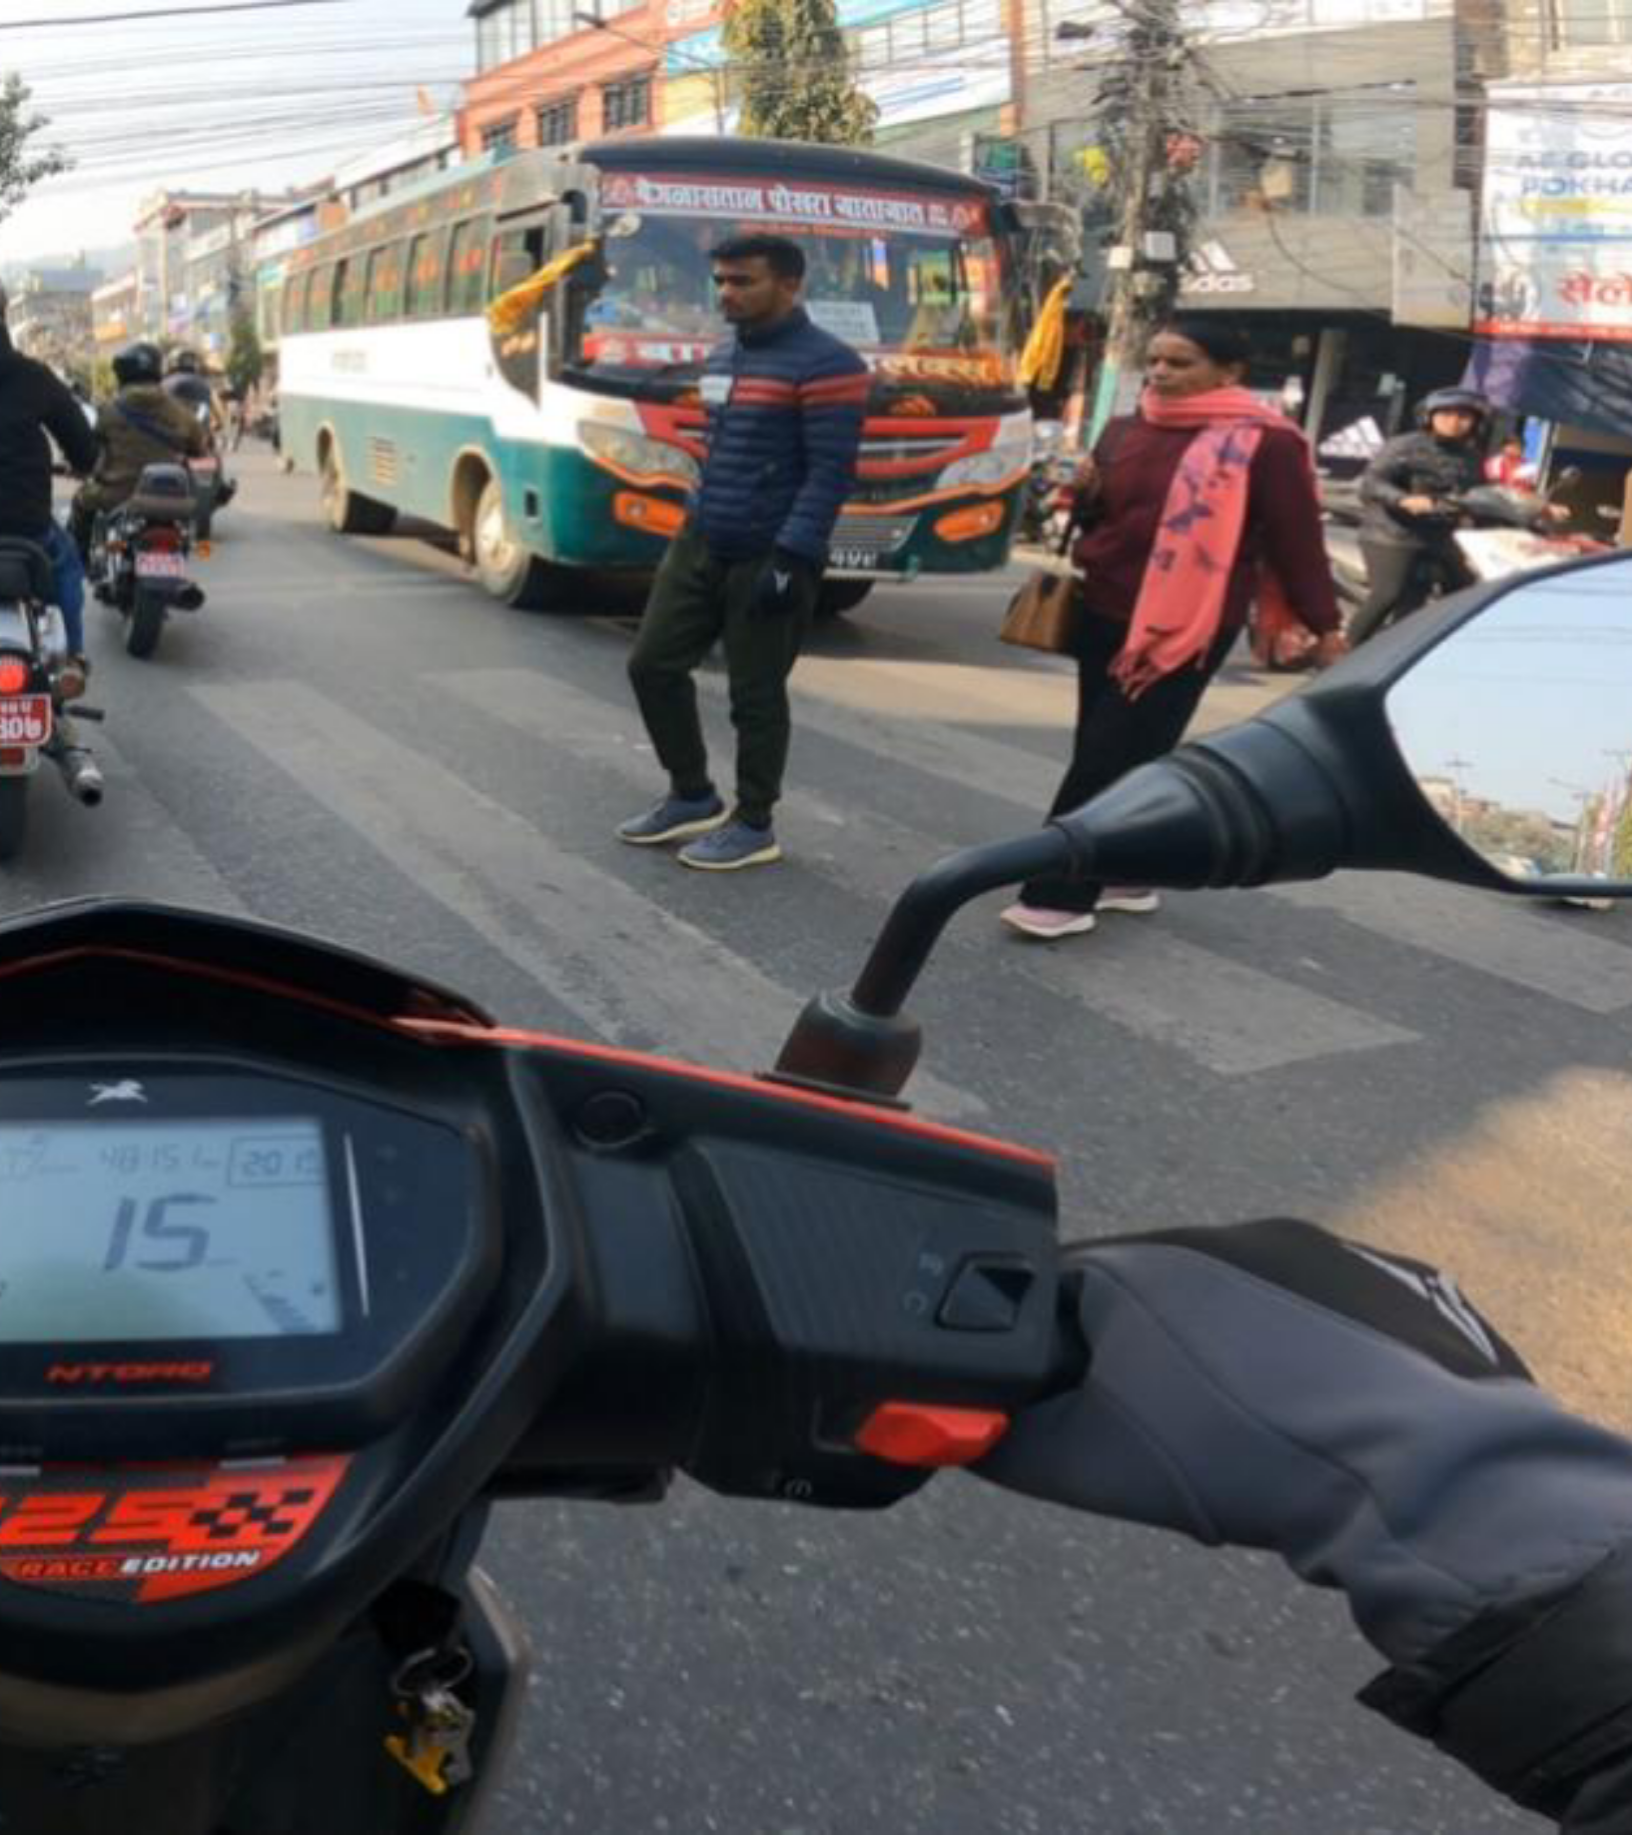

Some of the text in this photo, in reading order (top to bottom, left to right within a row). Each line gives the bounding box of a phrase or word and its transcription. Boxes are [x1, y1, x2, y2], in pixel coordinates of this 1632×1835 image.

[104, 1193, 217, 1271] 15
[20, 1550, 260, 1579] RACE EDITION
